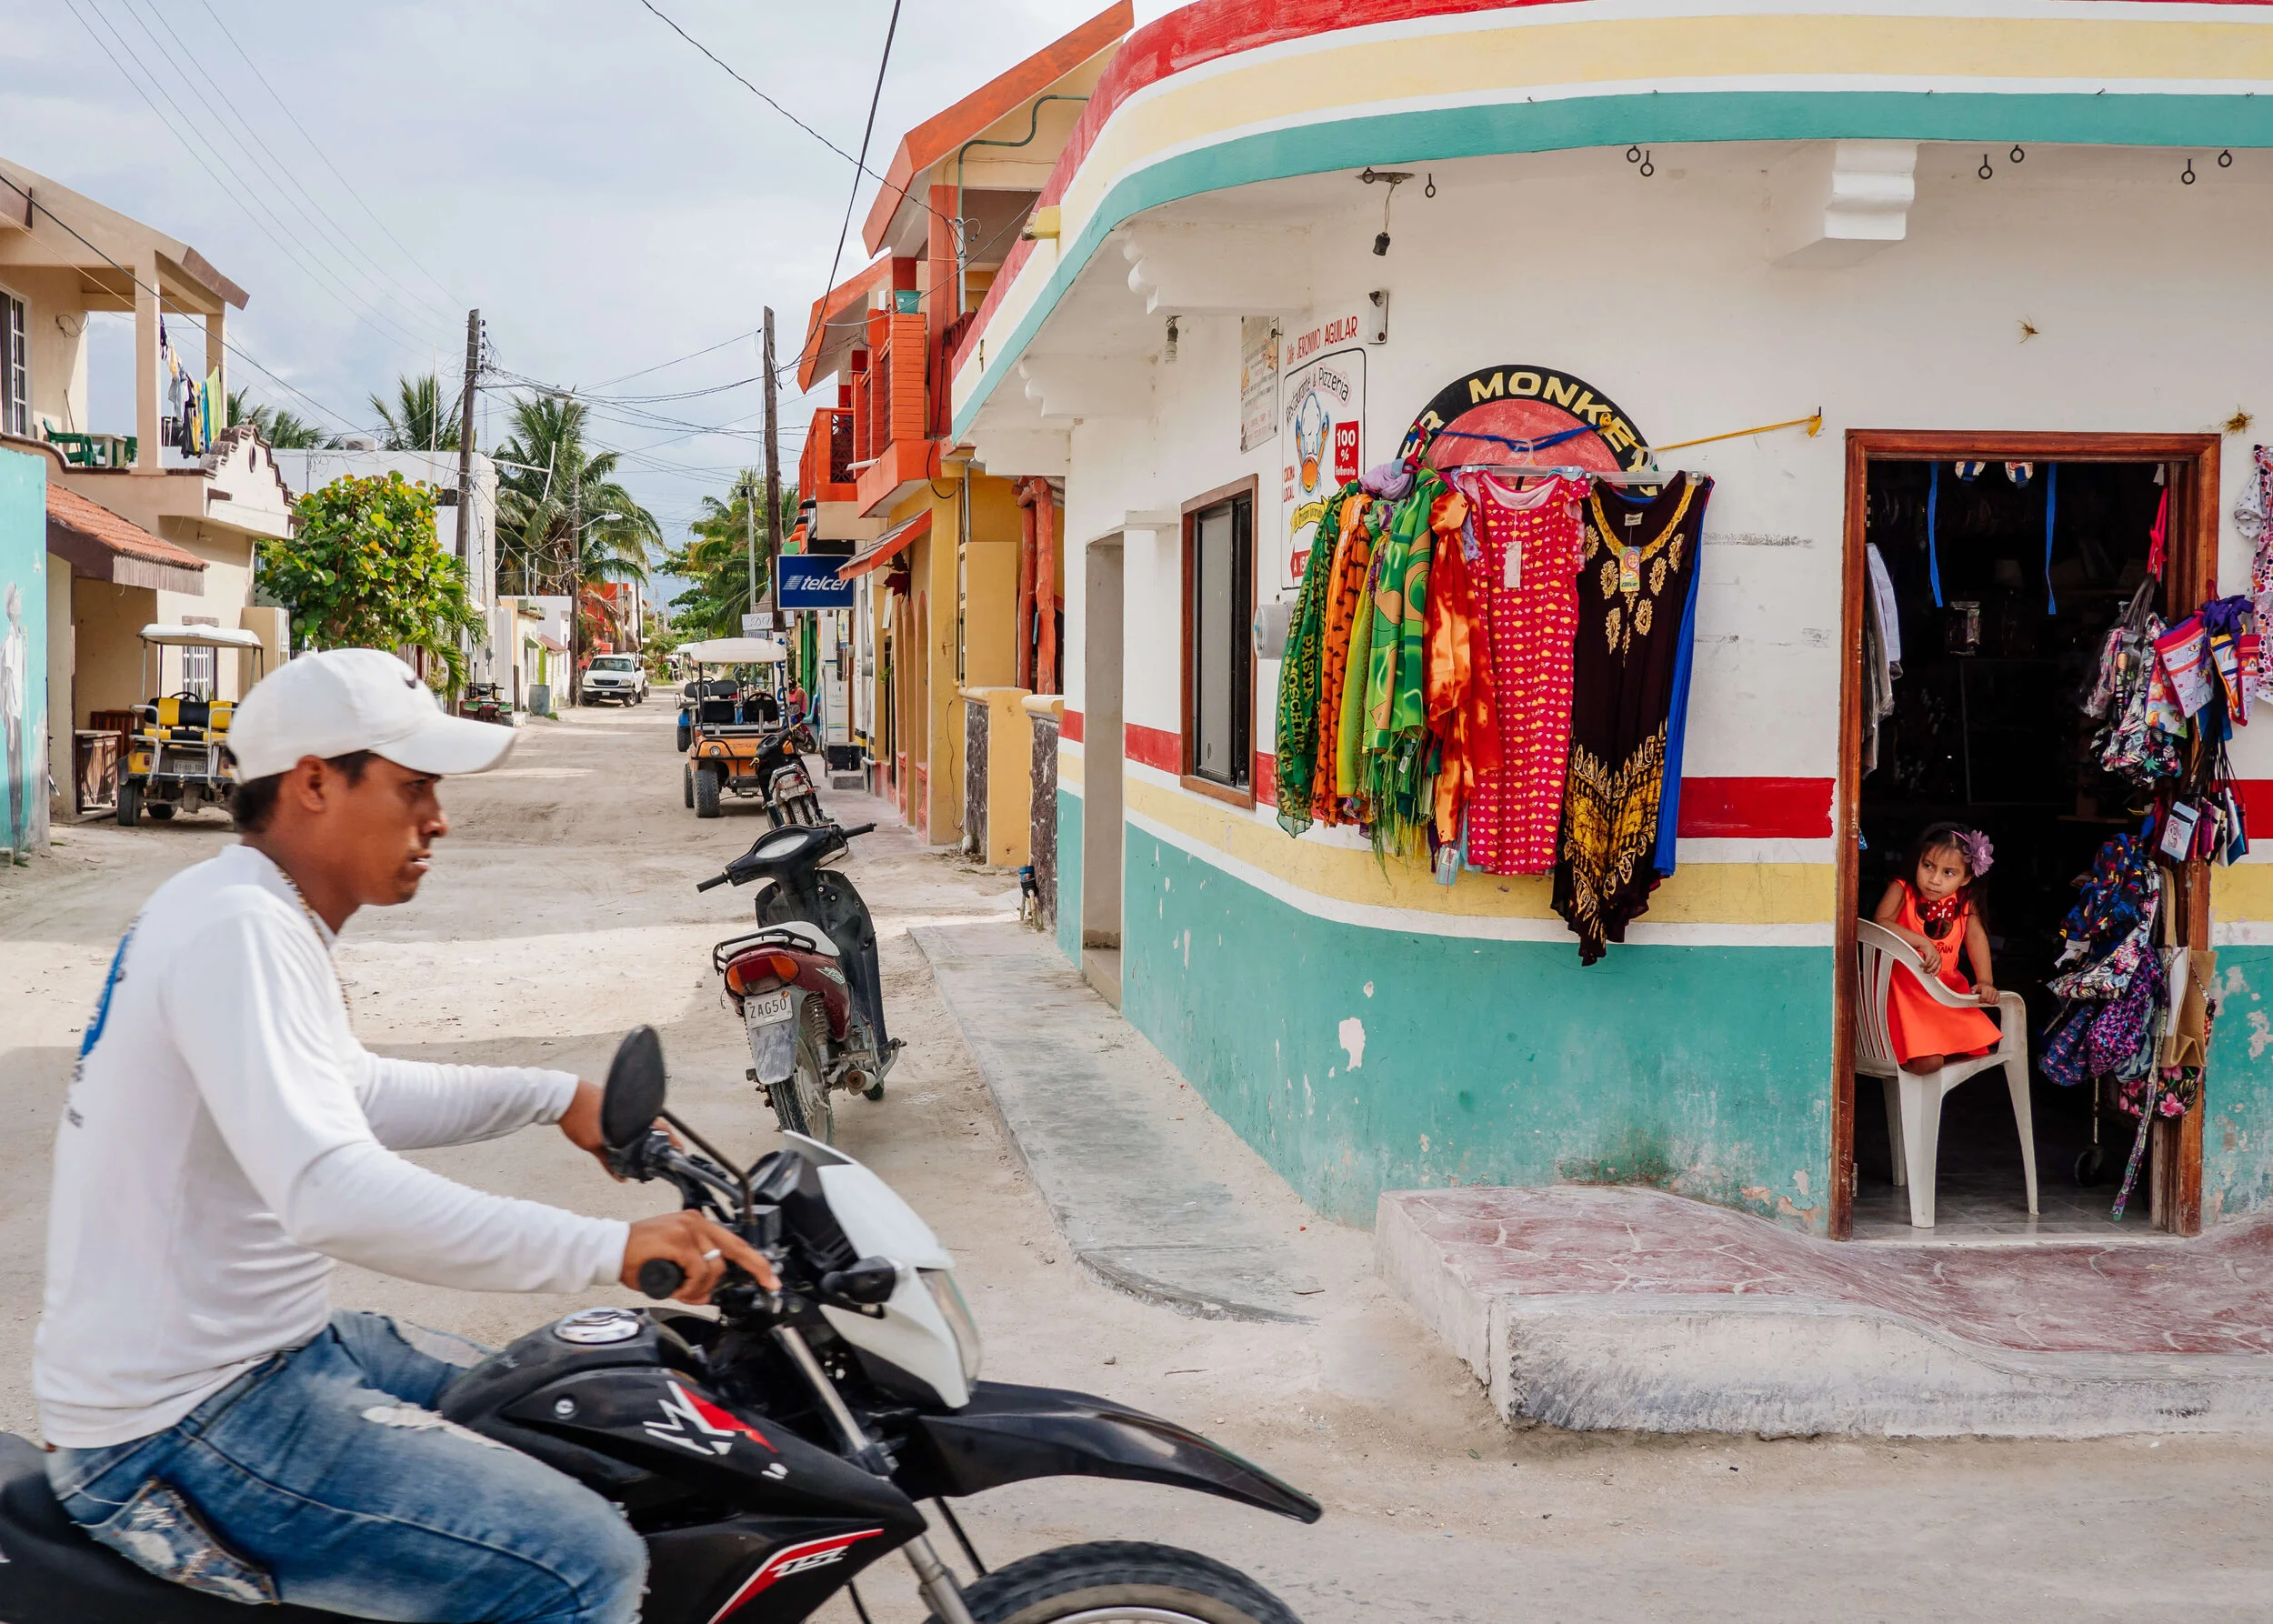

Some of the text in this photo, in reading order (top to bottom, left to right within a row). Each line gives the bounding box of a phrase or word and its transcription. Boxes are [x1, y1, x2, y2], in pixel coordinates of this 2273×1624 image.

[1297, 328, 1321, 359] JERONIMO
[1324, 316, 1357, 347] AGUILAR
[1319, 366, 1349, 402] Pizzeria
[1336, 428, 1357, 447] 100
[1340, 447, 1350, 463] %
[1283, 484, 1295, 503] LOCAL
[1293, 557, 1298, 574] A
[1301, 634, 1316, 703] PASTA
[748, 997, 787, 1019] ZAG50
